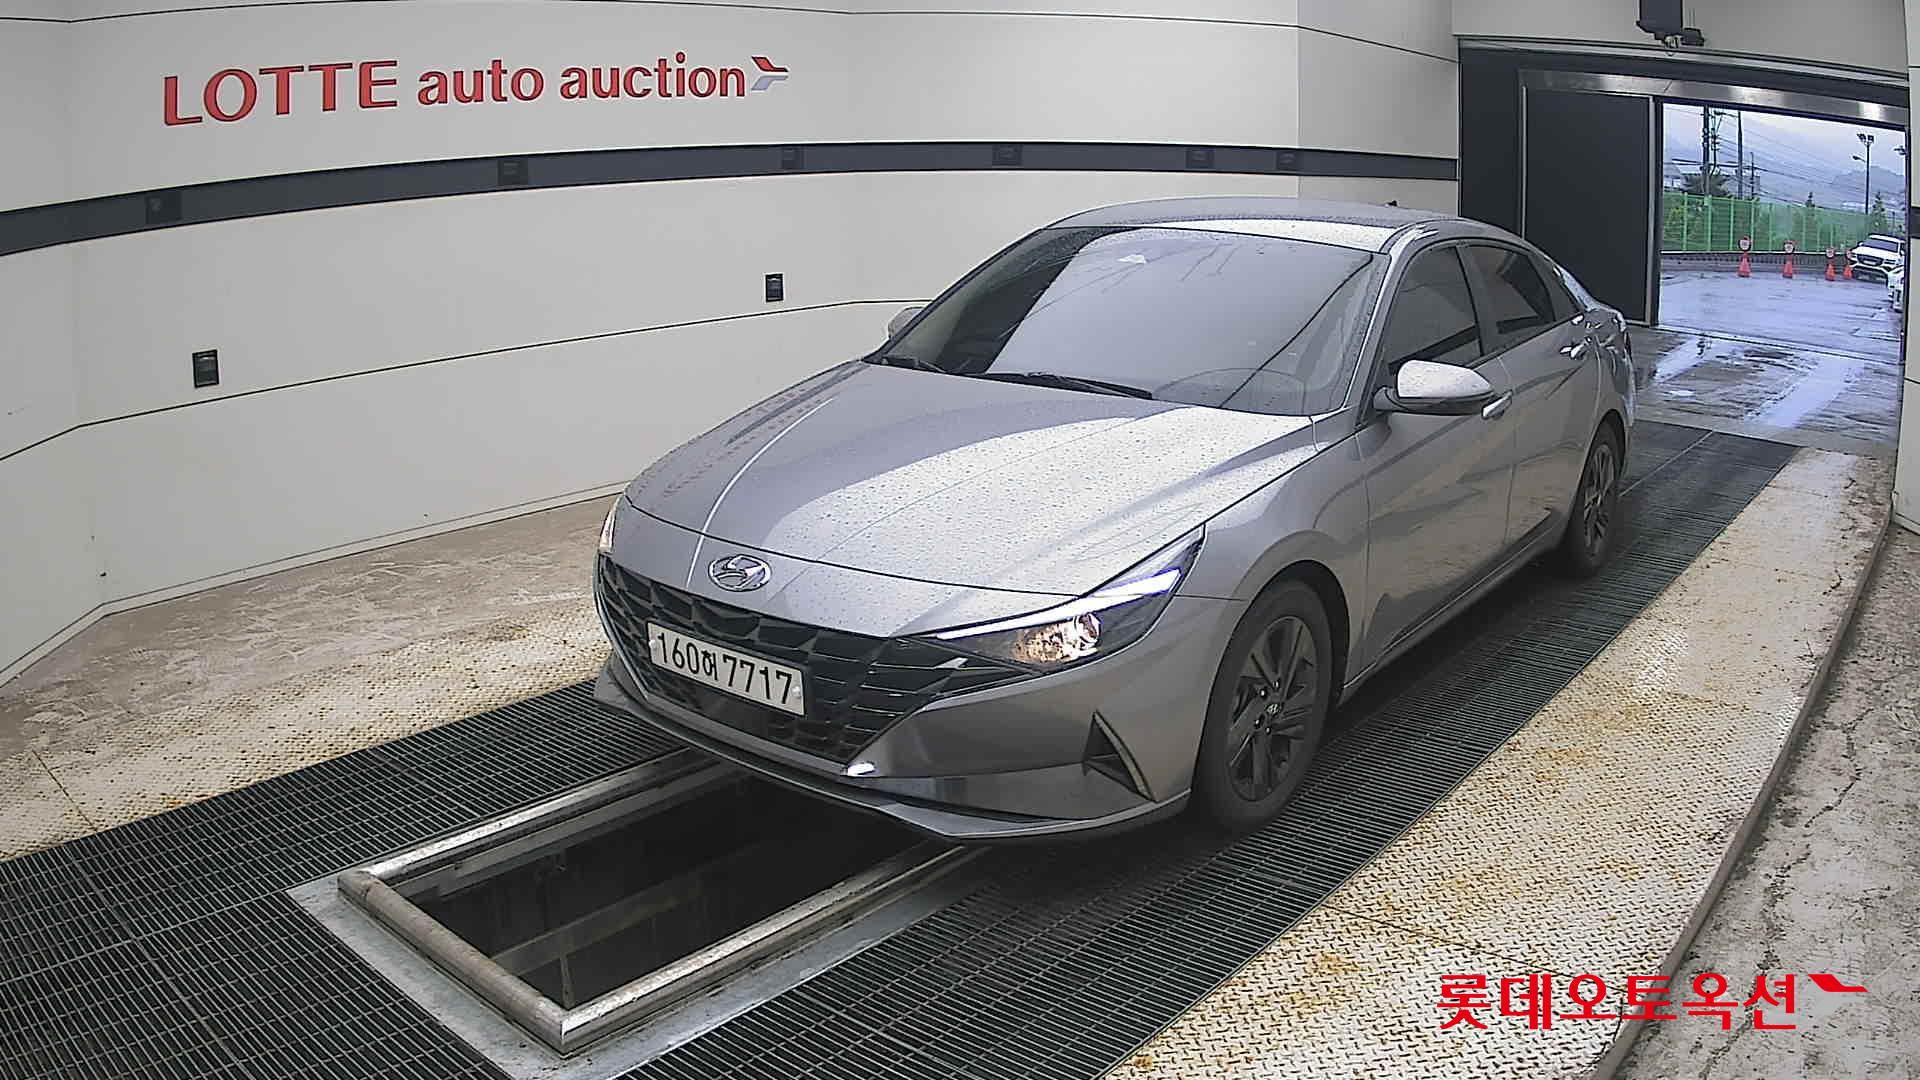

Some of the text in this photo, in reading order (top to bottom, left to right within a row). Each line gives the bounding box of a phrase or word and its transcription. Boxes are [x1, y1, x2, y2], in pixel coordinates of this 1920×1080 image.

[163, 51, 746, 127] LOTTE auto auction
